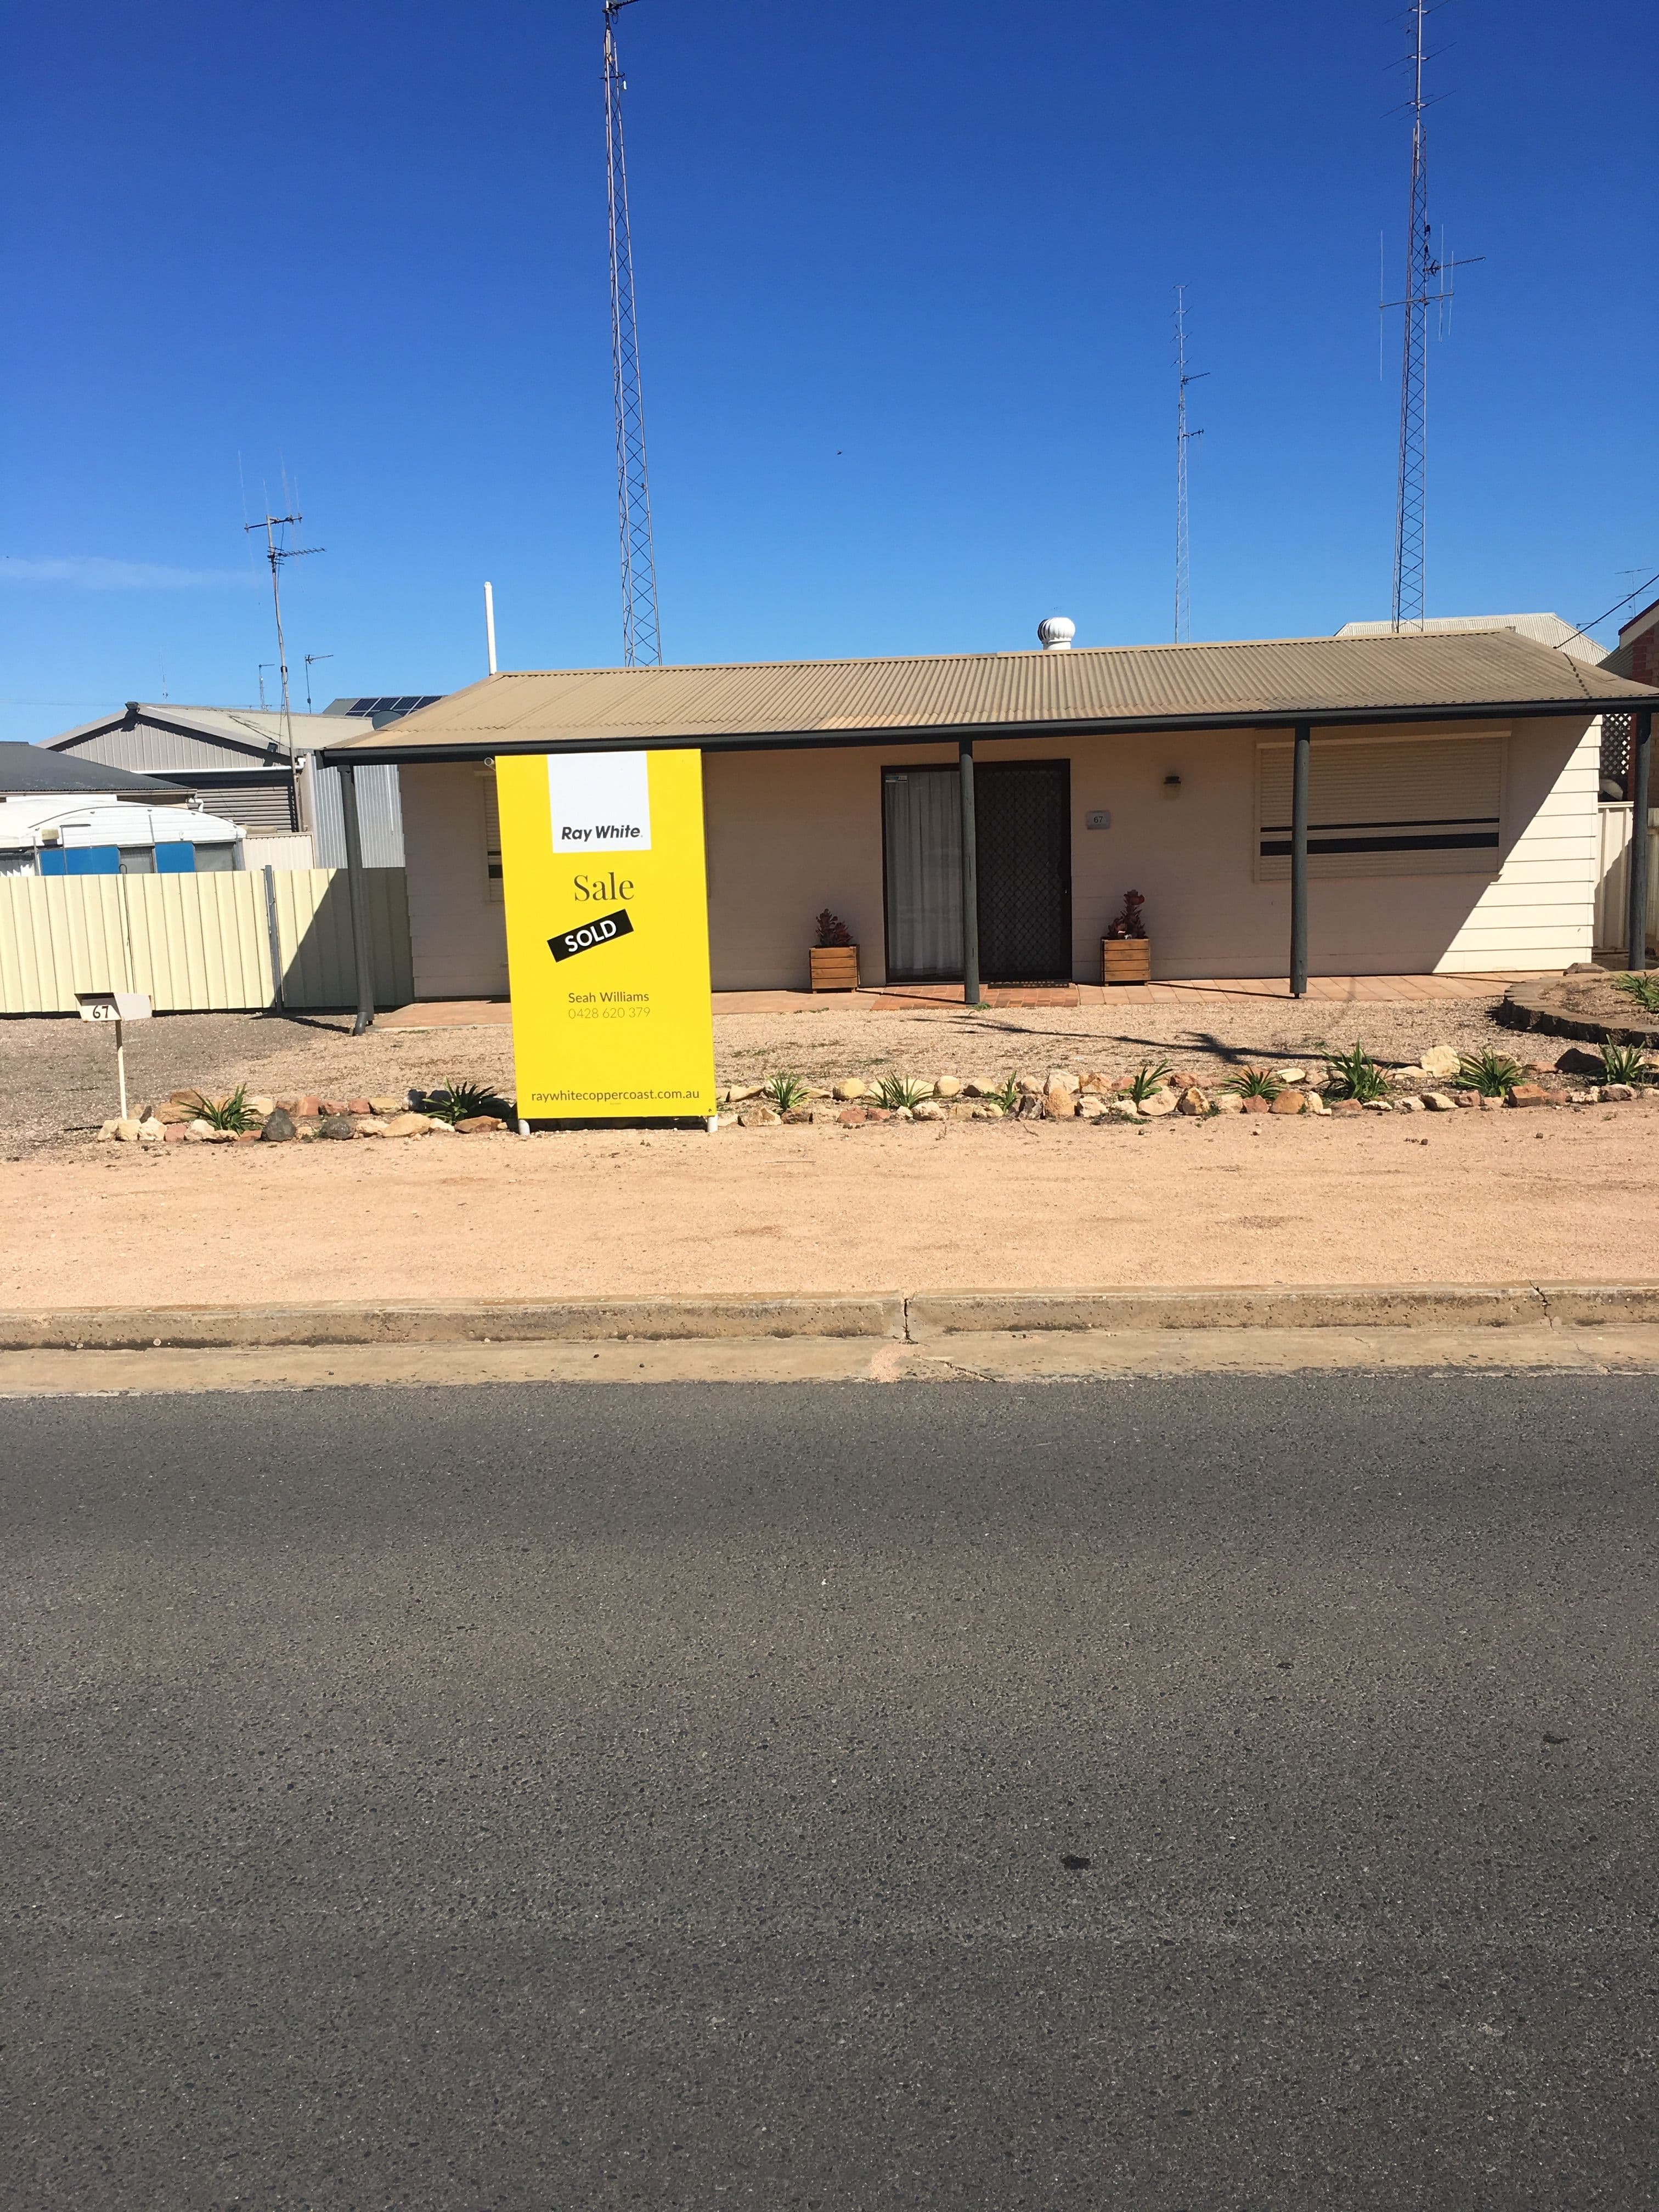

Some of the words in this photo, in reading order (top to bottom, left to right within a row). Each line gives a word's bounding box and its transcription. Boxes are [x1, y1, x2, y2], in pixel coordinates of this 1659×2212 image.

[562, 826, 592, 842] Ray
[596, 825, 640, 838] White
[574, 872, 634, 901] Sale
[565, 920, 617, 952] SOLD
[568, 992, 596, 1003] Seah
[600, 991, 649, 1002] Williams
[93, 1005, 109, 1019] 67
[568, 1008, 599, 1019] 0428
[602, 1008, 624, 1018] 620
[629, 1007, 650, 1018] 379
[531, 1090, 699, 1103] raywhitecoppercoast.com.au
